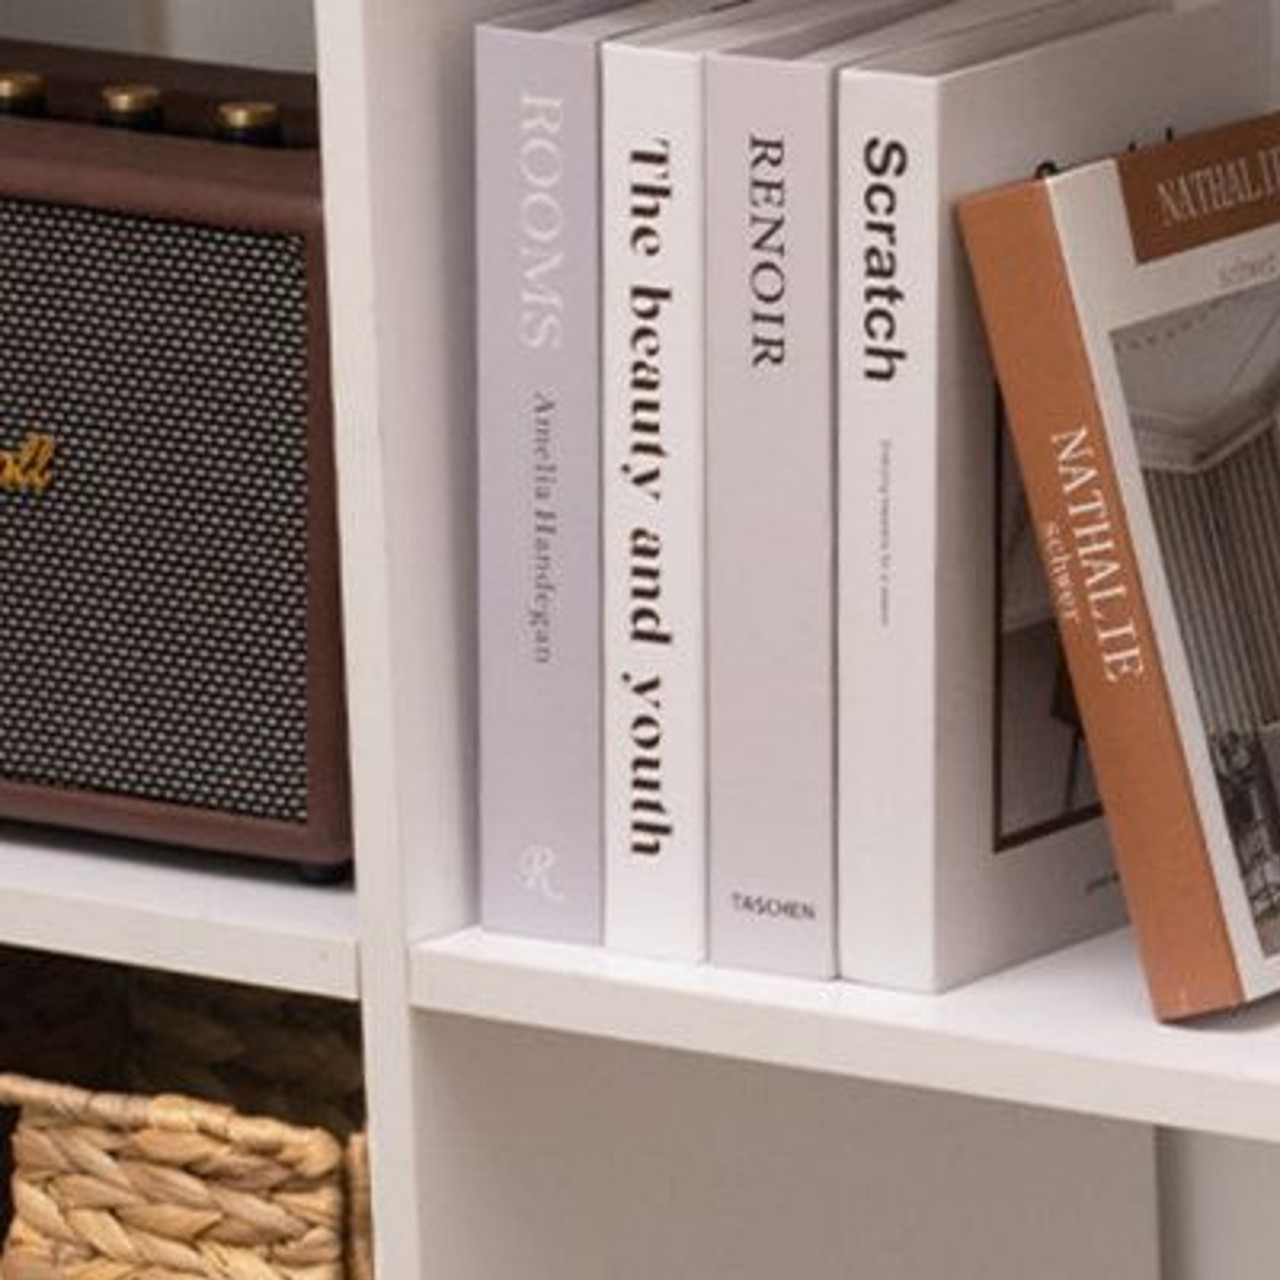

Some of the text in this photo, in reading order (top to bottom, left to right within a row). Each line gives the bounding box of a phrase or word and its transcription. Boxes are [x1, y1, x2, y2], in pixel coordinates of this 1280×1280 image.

[520, 94, 564, 350] ROOMS
[749, 133, 786, 369] RENOIR
[863, 136, 908, 382] Scratch
[532, 393, 559, 500] Amelia
[620, 136, 674, 856] The beauty and youth
[1052, 426, 1144, 684] NATHALIE
[731, 892, 816, 921] TASCHEN
